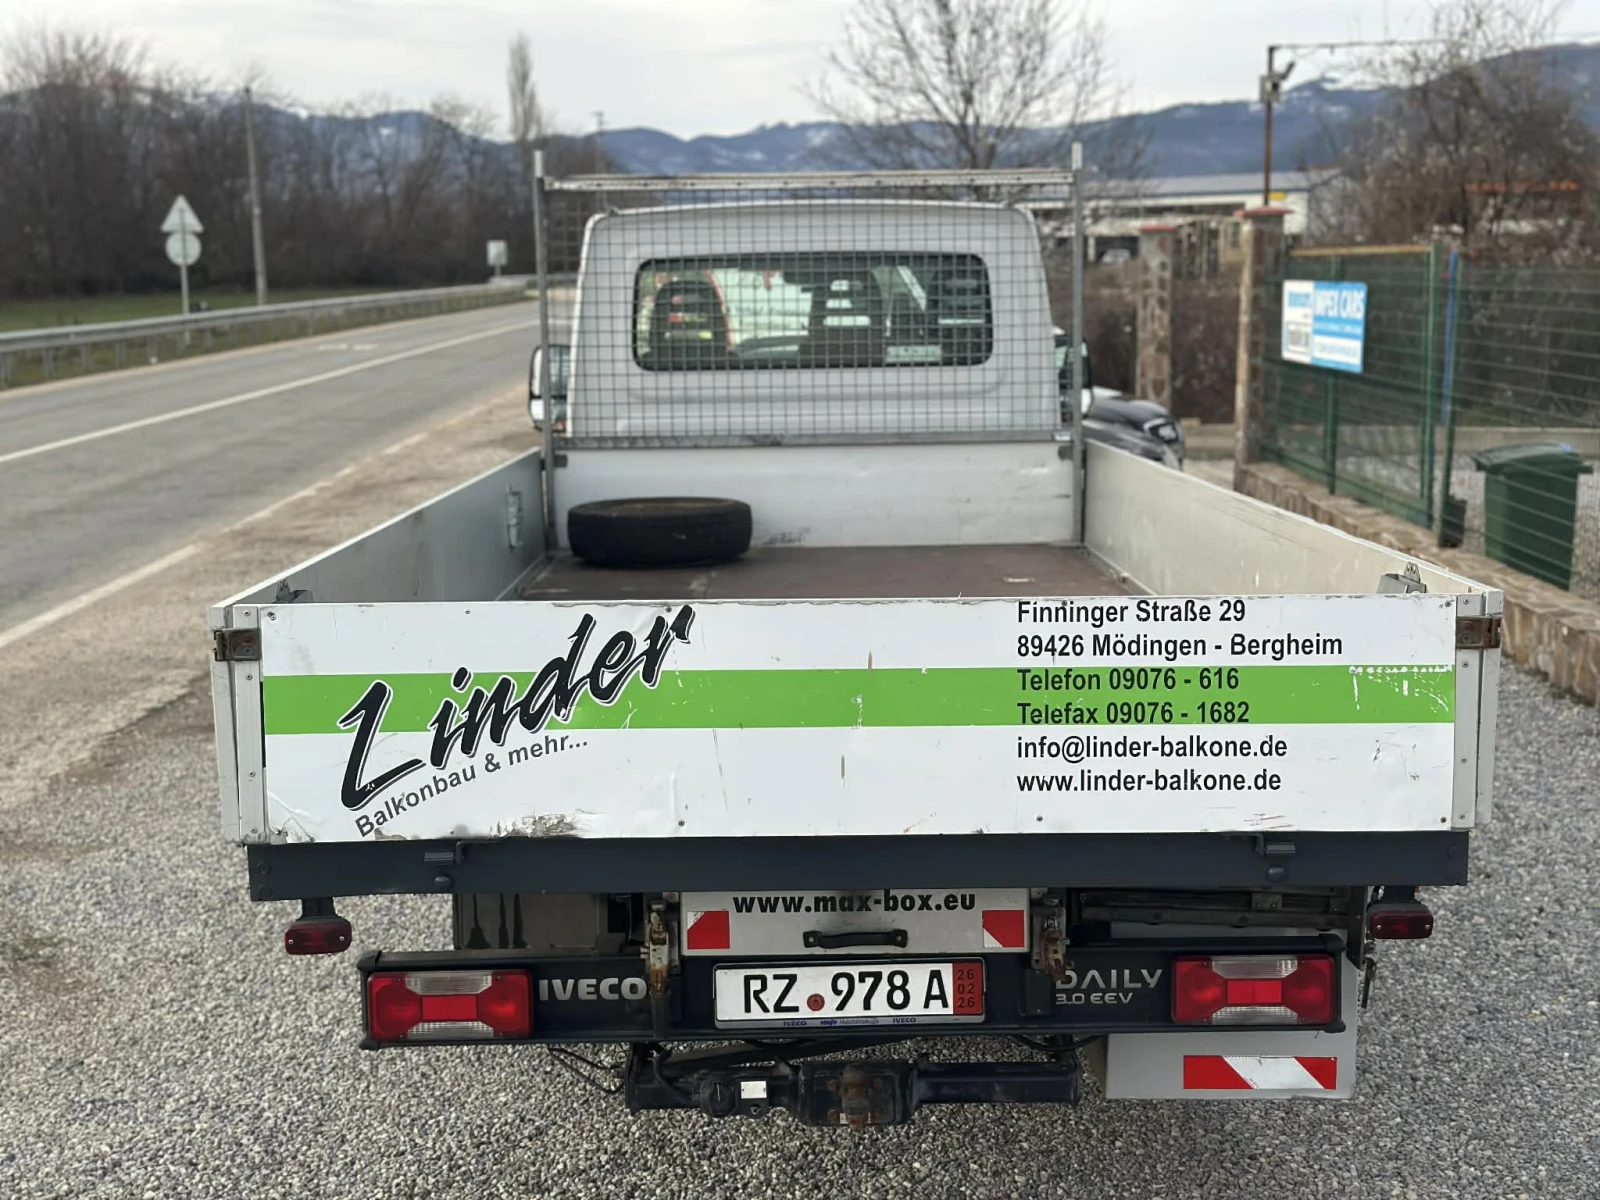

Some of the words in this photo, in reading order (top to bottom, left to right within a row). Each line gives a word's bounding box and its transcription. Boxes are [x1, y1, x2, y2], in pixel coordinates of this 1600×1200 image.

[1017, 601, 1129, 628] Finninger
[1135, 600, 1212, 622] Straße
[1218, 600, 1246, 622] 29
[1017, 634, 1085, 657] 89426
[1092, 634, 1207, 662] Mödingen
[1230, 633, 1343, 661] Bergheim
[1017, 669, 1101, 691] Telefon
[1108, 668, 1177, 690] 09076
[1199, 668, 1240, 690] 616
[338, 605, 696, 811] Linder
[1017, 703, 1099, 725] Telefax
[1106, 702, 1174, 724] 09076
[1196, 702, 1250, 723] 1682
[1017, 735, 1288, 763] info@linder-balkone.de
[354, 763, 477, 838] Balkonbau
[484, 754, 501, 774] &
[507, 734, 589, 766] mehr...
[1017, 769, 1282, 792] www.linder-balkone.de
[733, 889, 976, 913] www.max-box.eu
[539, 977, 648, 1001] IVECO
[957, 983, 975, 996] 02
[1055, 969, 1163, 989] DAILY
[744, 974, 800, 1014] RZ
[831, 970, 910, 1012] 978
[923, 970, 949, 1009] A
[957, 997, 976, 1010] 26
[1090, 992, 1134, 1004] EEV
